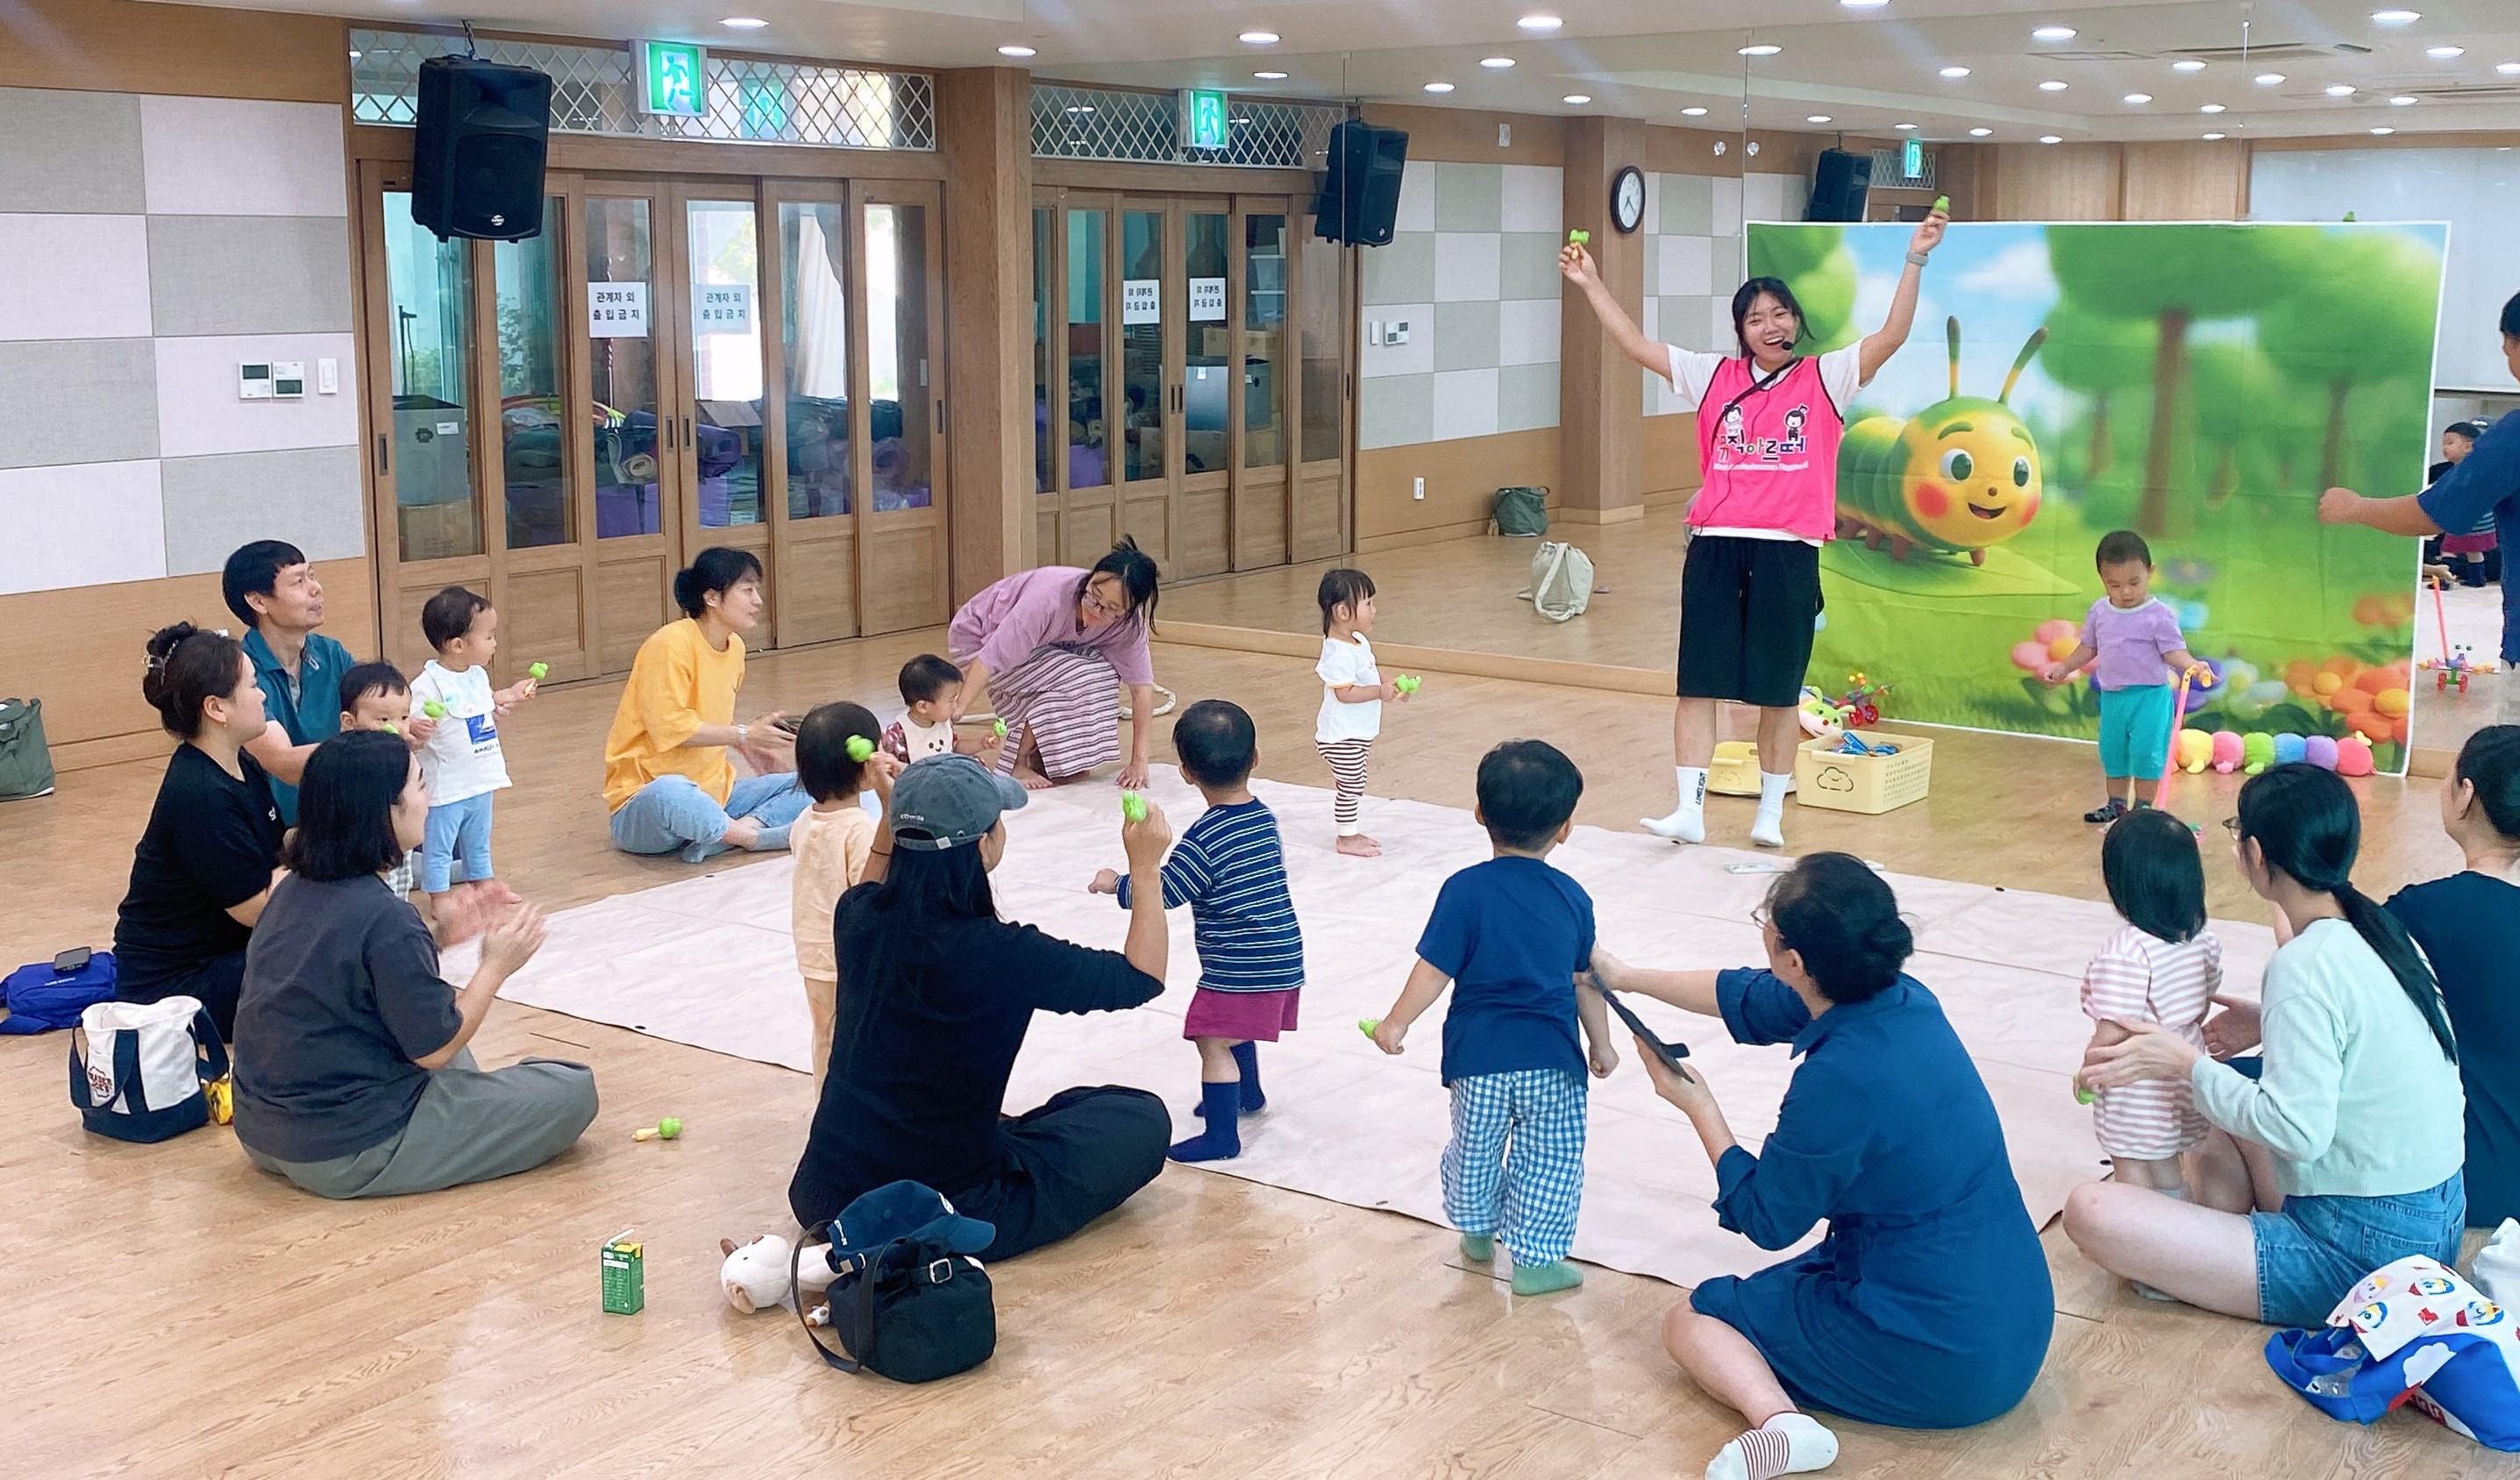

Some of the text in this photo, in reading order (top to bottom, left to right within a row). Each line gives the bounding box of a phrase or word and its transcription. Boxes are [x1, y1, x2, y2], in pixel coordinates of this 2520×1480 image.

[596, 292, 635, 303] 관계자 외
[706, 292, 742, 303] 관계자 외
